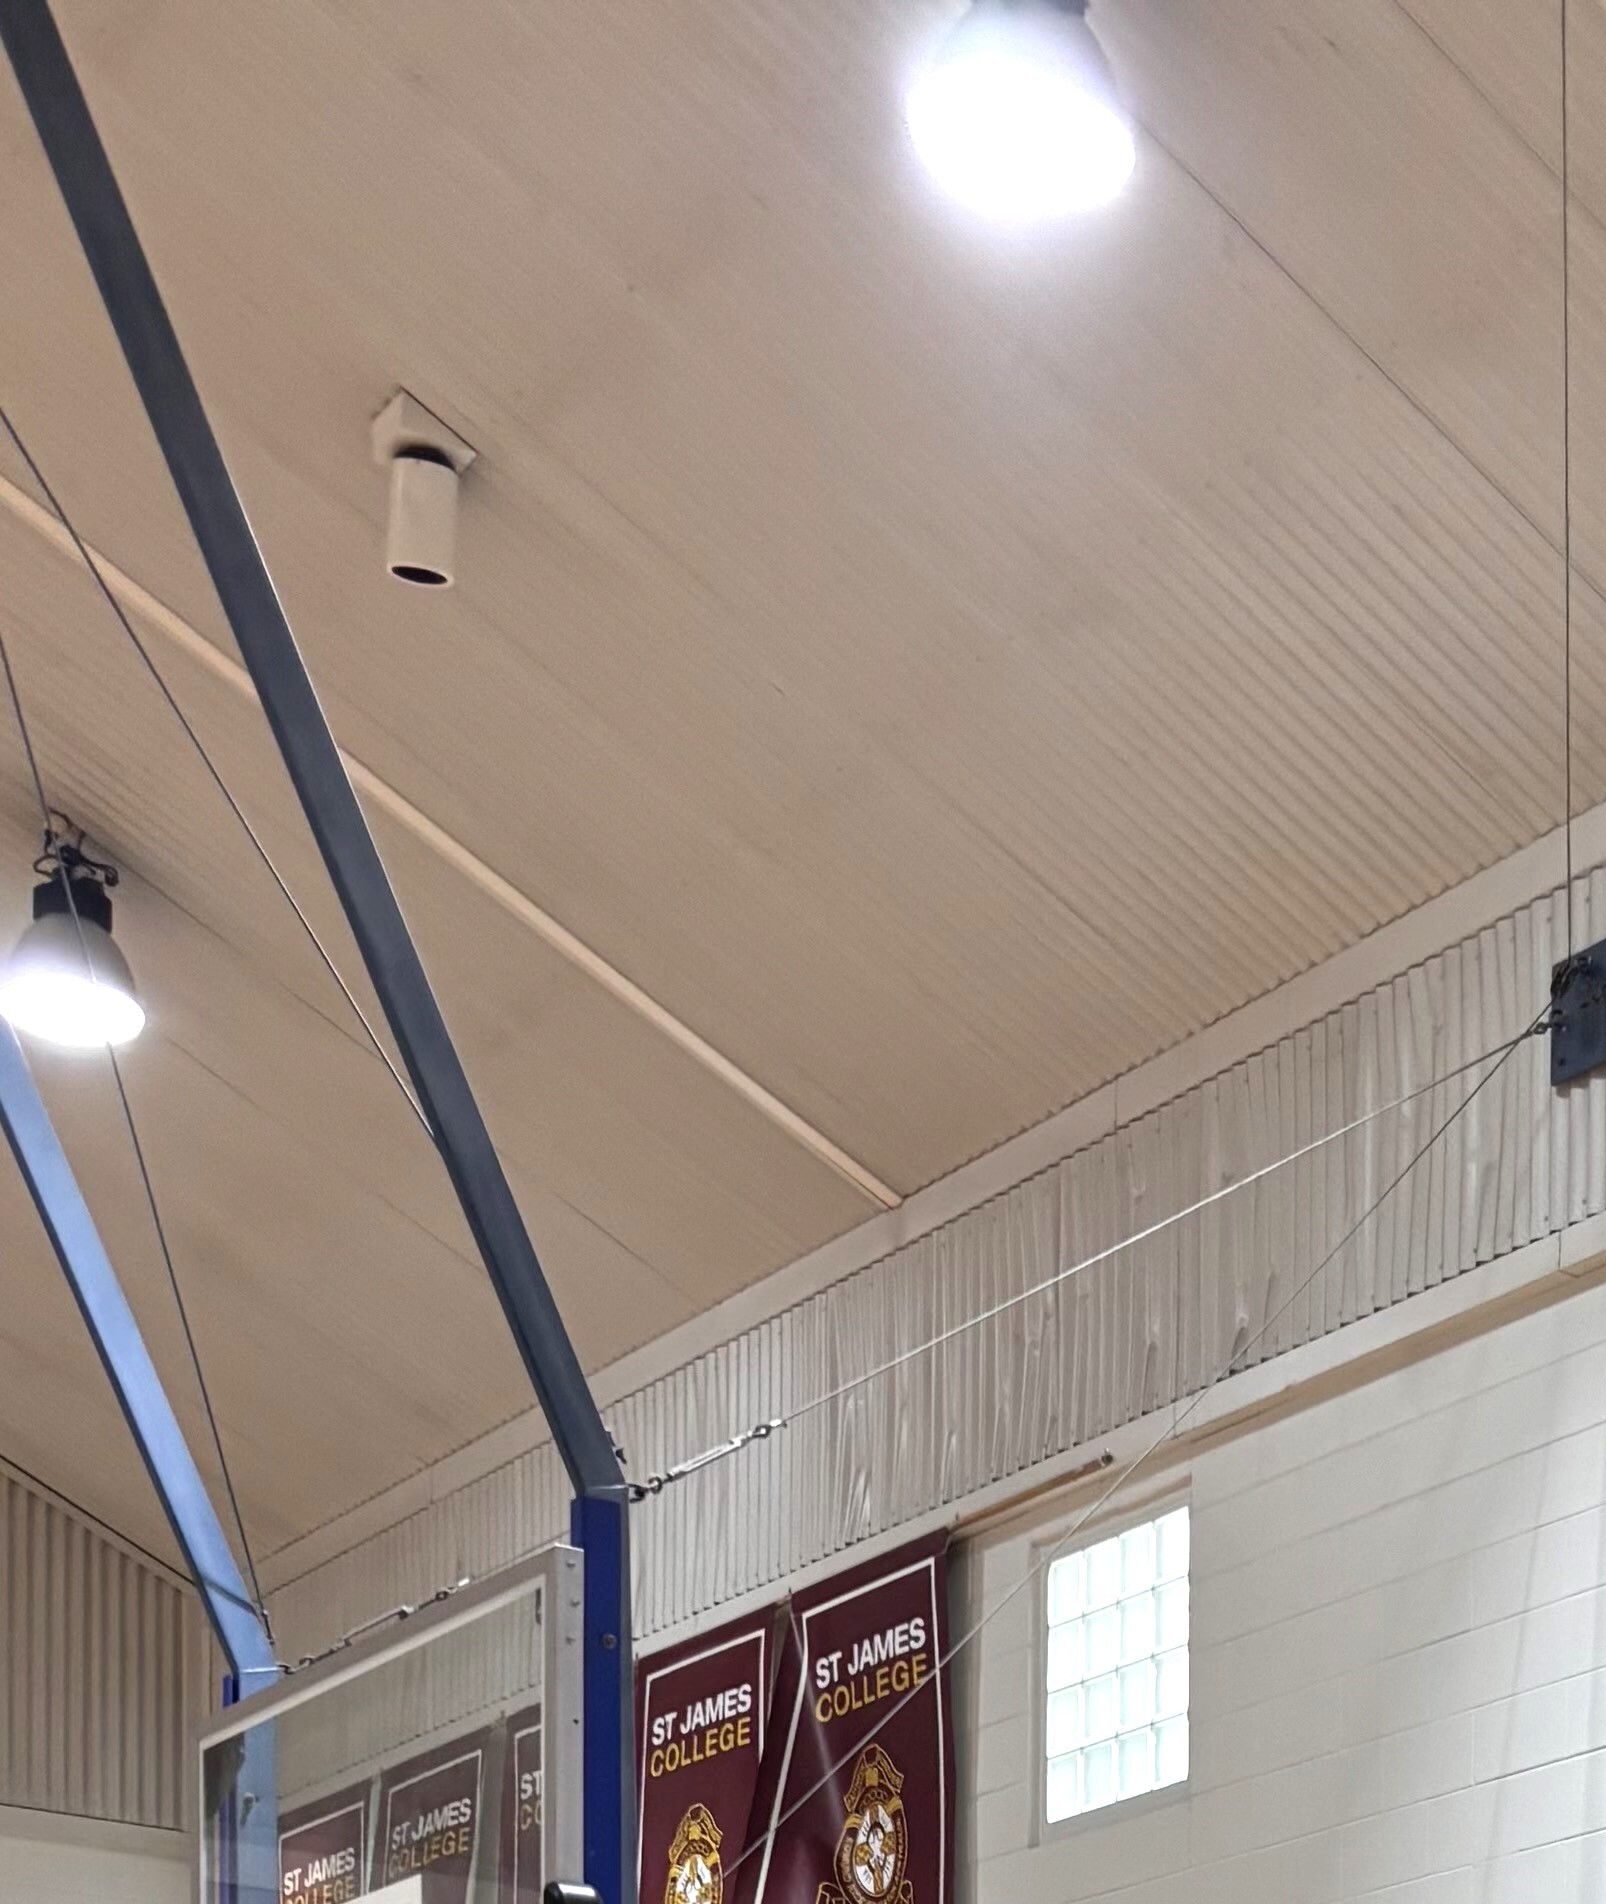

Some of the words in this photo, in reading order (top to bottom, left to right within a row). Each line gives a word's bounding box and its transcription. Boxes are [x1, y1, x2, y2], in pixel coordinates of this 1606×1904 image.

[815, 1651, 843, 1689] ST
[847, 1617, 927, 1676] JAMES
[652, 1715, 673, 1746] ST
[680, 1684, 752, 1734] JAMES
[815, 1652, 928, 1724] COLLEGE
[650, 1716, 751, 1778] COLLEGE
[388, 1827, 470, 1879] COLLEGE
[391, 1823, 410, 1850] ST
[411, 1798, 472, 1839] JAMES
[284, 1868, 302, 1896] ST
[304, 1847, 355, 1888] JAMES
